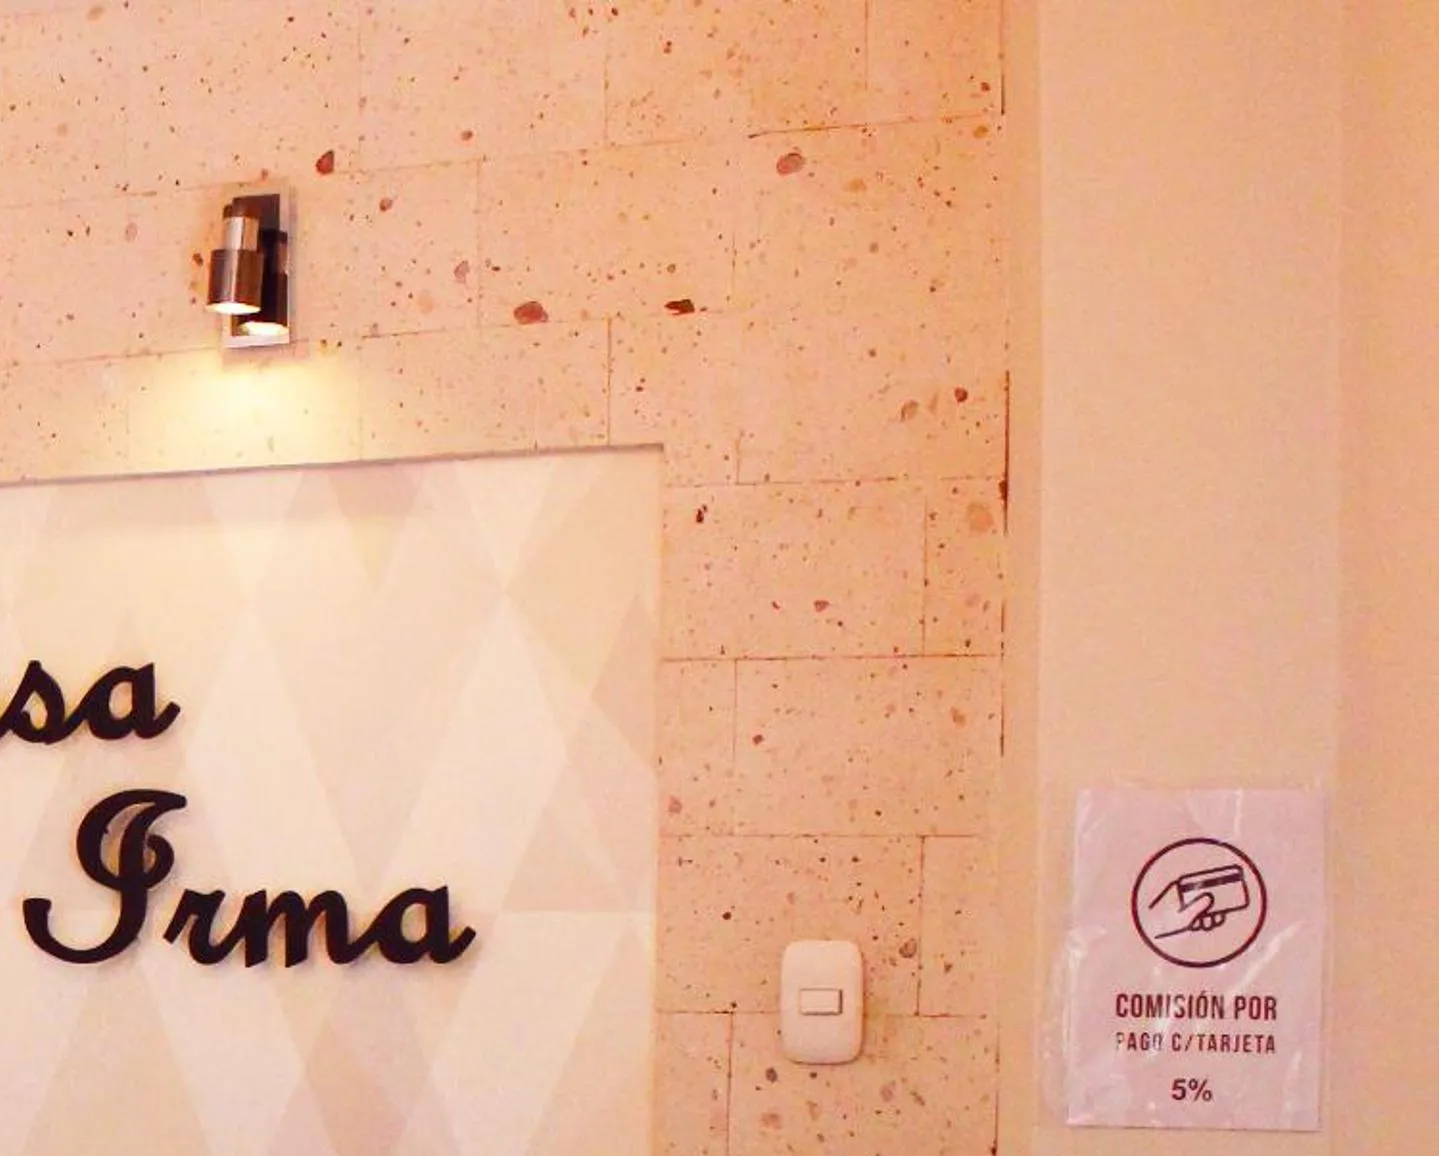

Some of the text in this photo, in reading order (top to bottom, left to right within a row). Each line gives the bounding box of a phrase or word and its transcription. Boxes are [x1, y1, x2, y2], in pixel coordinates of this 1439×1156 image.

[22, 788, 477, 968] Irma
[1115, 990, 1278, 1021] COMISIÓN POR
[1171, 1078, 1213, 1102] 5%
